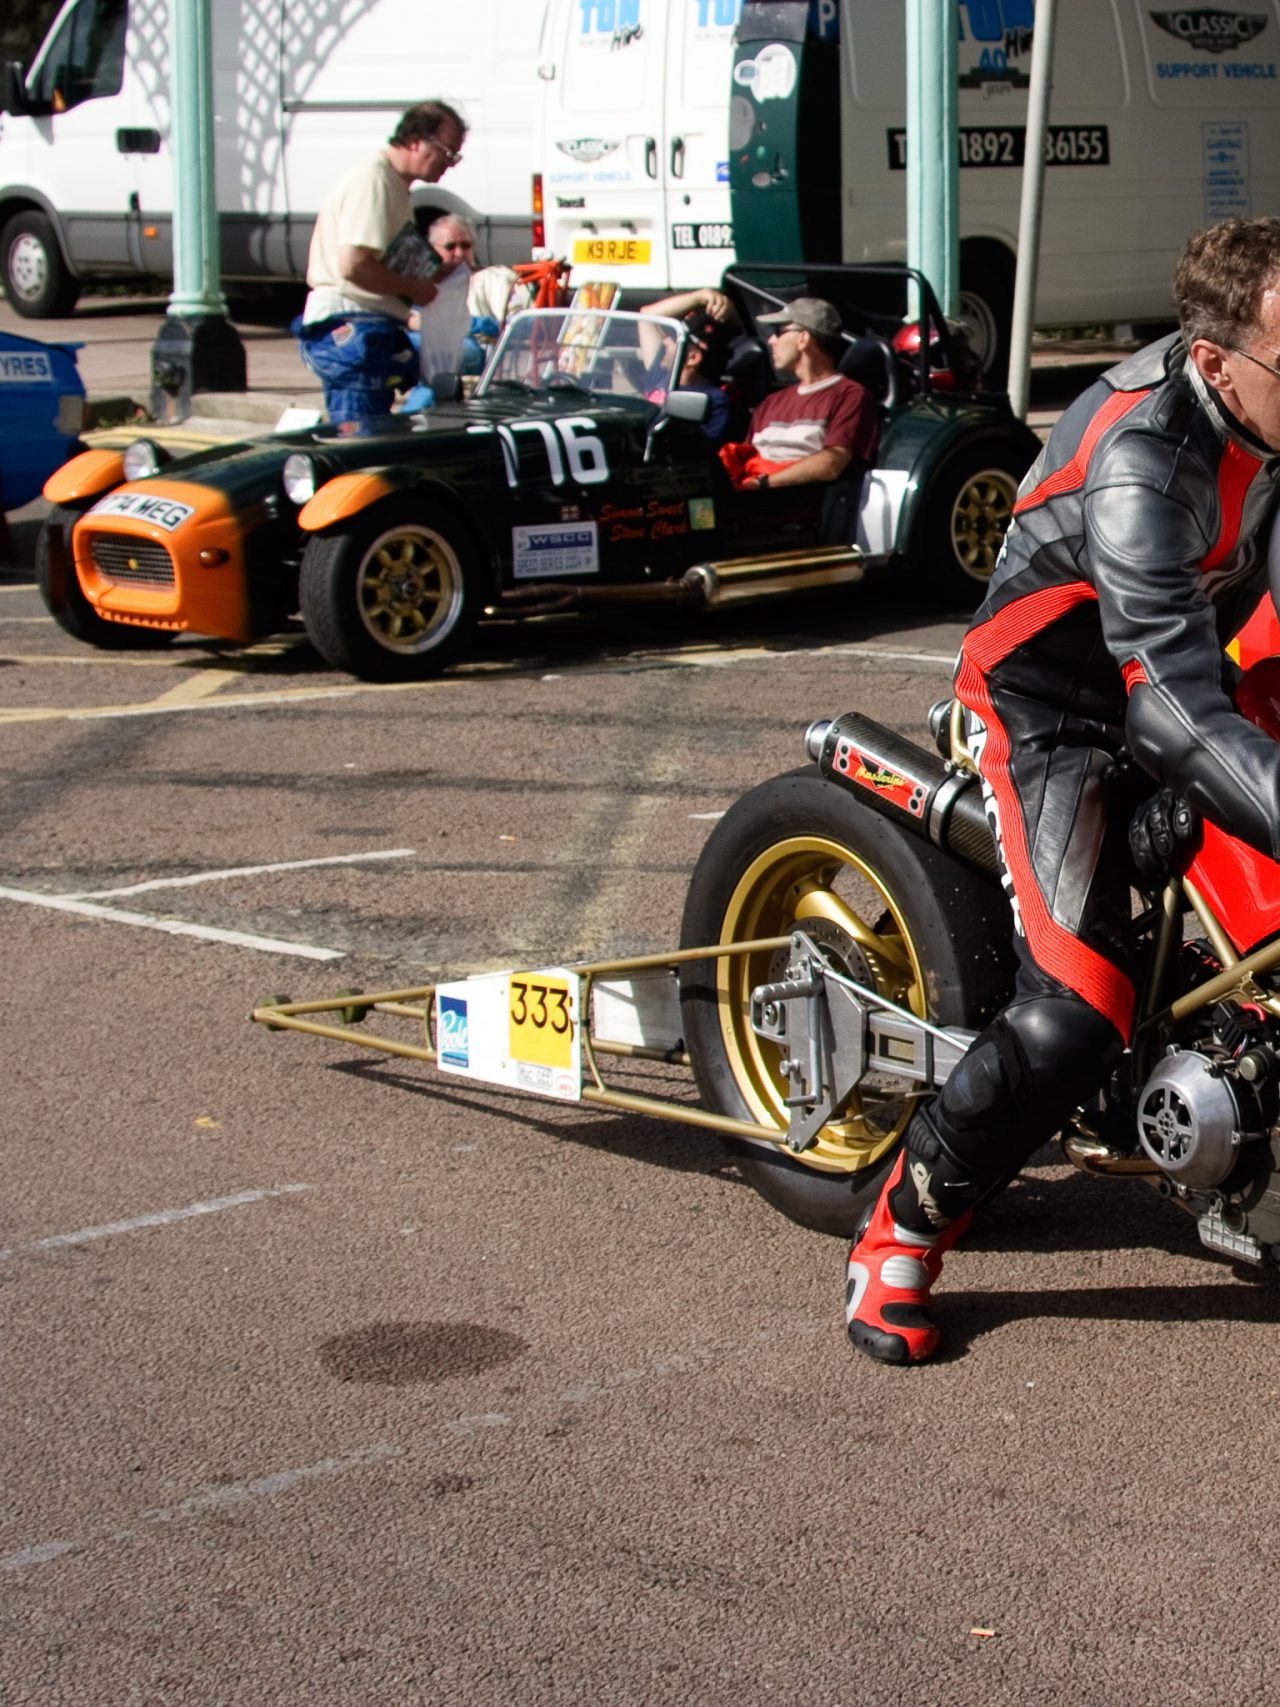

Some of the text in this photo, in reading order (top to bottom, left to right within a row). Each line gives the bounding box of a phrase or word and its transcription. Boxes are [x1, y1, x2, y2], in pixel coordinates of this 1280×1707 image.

[1174, 14, 1248, 37] CLASSIC
[1156, 63, 1276, 78] SUPPORT VEHICLE
[957, 132, 1015, 162] 1892
[550, 173, 588, 183] SUPPORT
[674, 225, 735, 247] TEL 0189
[530, 532, 591, 549] WSCC
[510, 981, 569, 1035] 333
